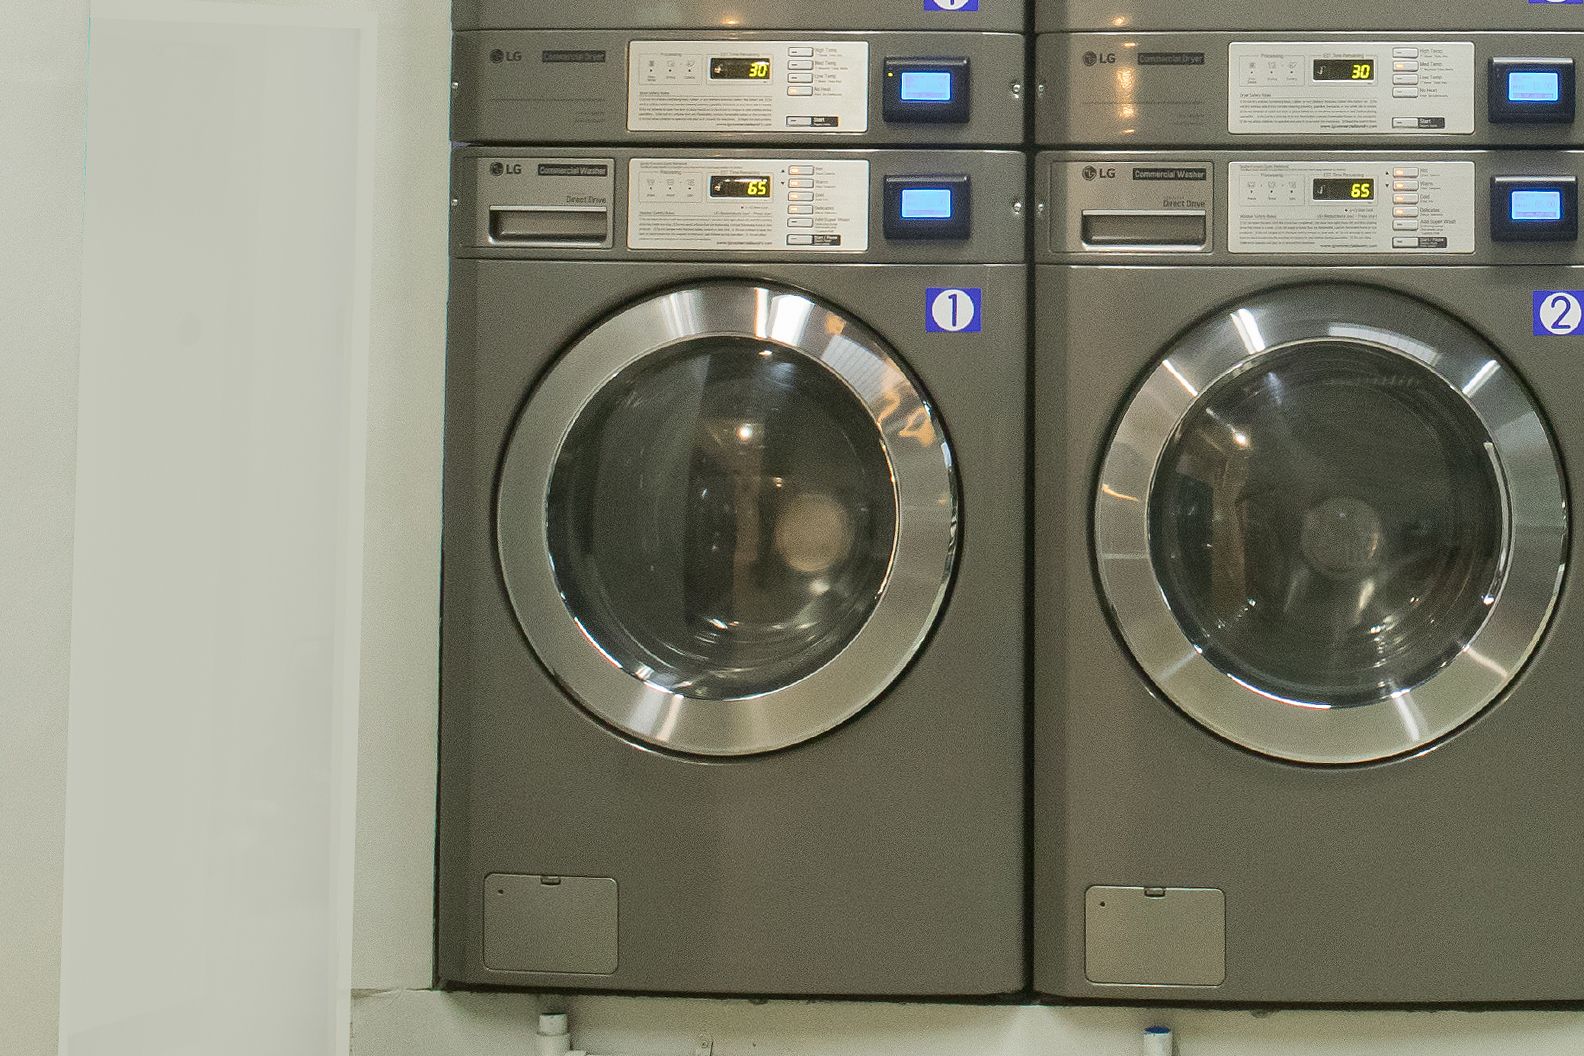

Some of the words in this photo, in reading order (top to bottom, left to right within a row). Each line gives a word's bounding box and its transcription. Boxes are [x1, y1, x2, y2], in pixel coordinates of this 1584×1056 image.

[506, 51, 522, 62] LG
[1100, 53, 1116, 63] LG
[748, 61, 768, 78] 30
[1351, 64, 1371, 79] 30
[506, 164, 522, 175] LG
[1099, 168, 1116, 179] LG
[747, 180, 767, 195] 65
[1350, 183, 1370, 198] 65
[947, 293, 958, 327] 1
[1550, 295, 1572, 330] 2
